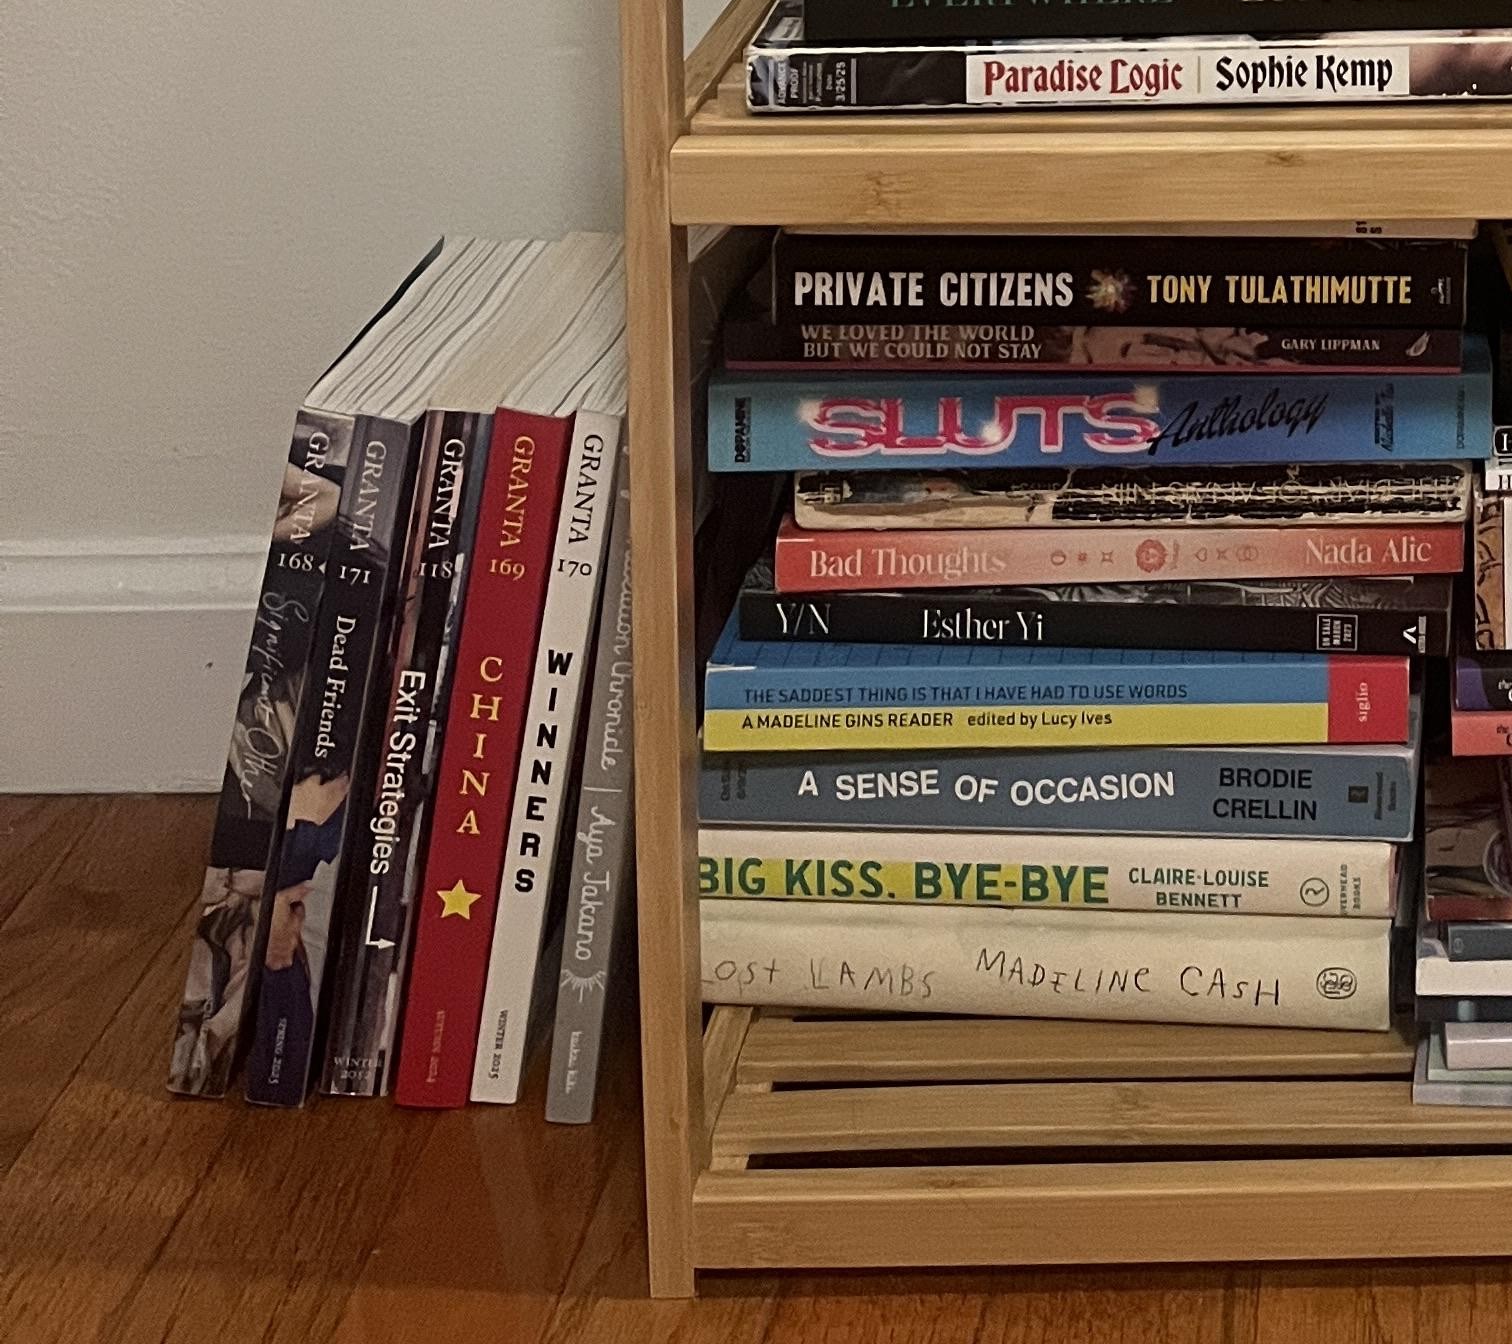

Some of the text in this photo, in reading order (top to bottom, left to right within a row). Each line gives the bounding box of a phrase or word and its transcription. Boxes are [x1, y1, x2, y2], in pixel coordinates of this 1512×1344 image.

[1215, 54, 1394, 91] Sophie Kemp
[794, 272, 1074, 307] PRIVATE CITIZENS
[1147, 274, 1412, 304] TONY TULATHIMUTTE
[1281, 338, 1381, 352] GARY LIPPMAN
[500, 436, 535, 547] GRANTA
[568, 434, 603, 544] GRANTA
[490, 560, 524, 581] 169
[558, 559, 592, 576] 170
[968, 710, 1112, 730] edited by Lucy Ives
[370, 670, 426, 875] Exit Strategies
[1219, 768, 1313, 789] BRODIE
[798, 770, 1175, 806] A SENSE OF OCCASION
[1213, 797, 1317, 821] CRELLIN
[1129, 866, 1269, 887] CLAIRE-LOUISE
[1156, 891, 1242, 909] BENNETT
